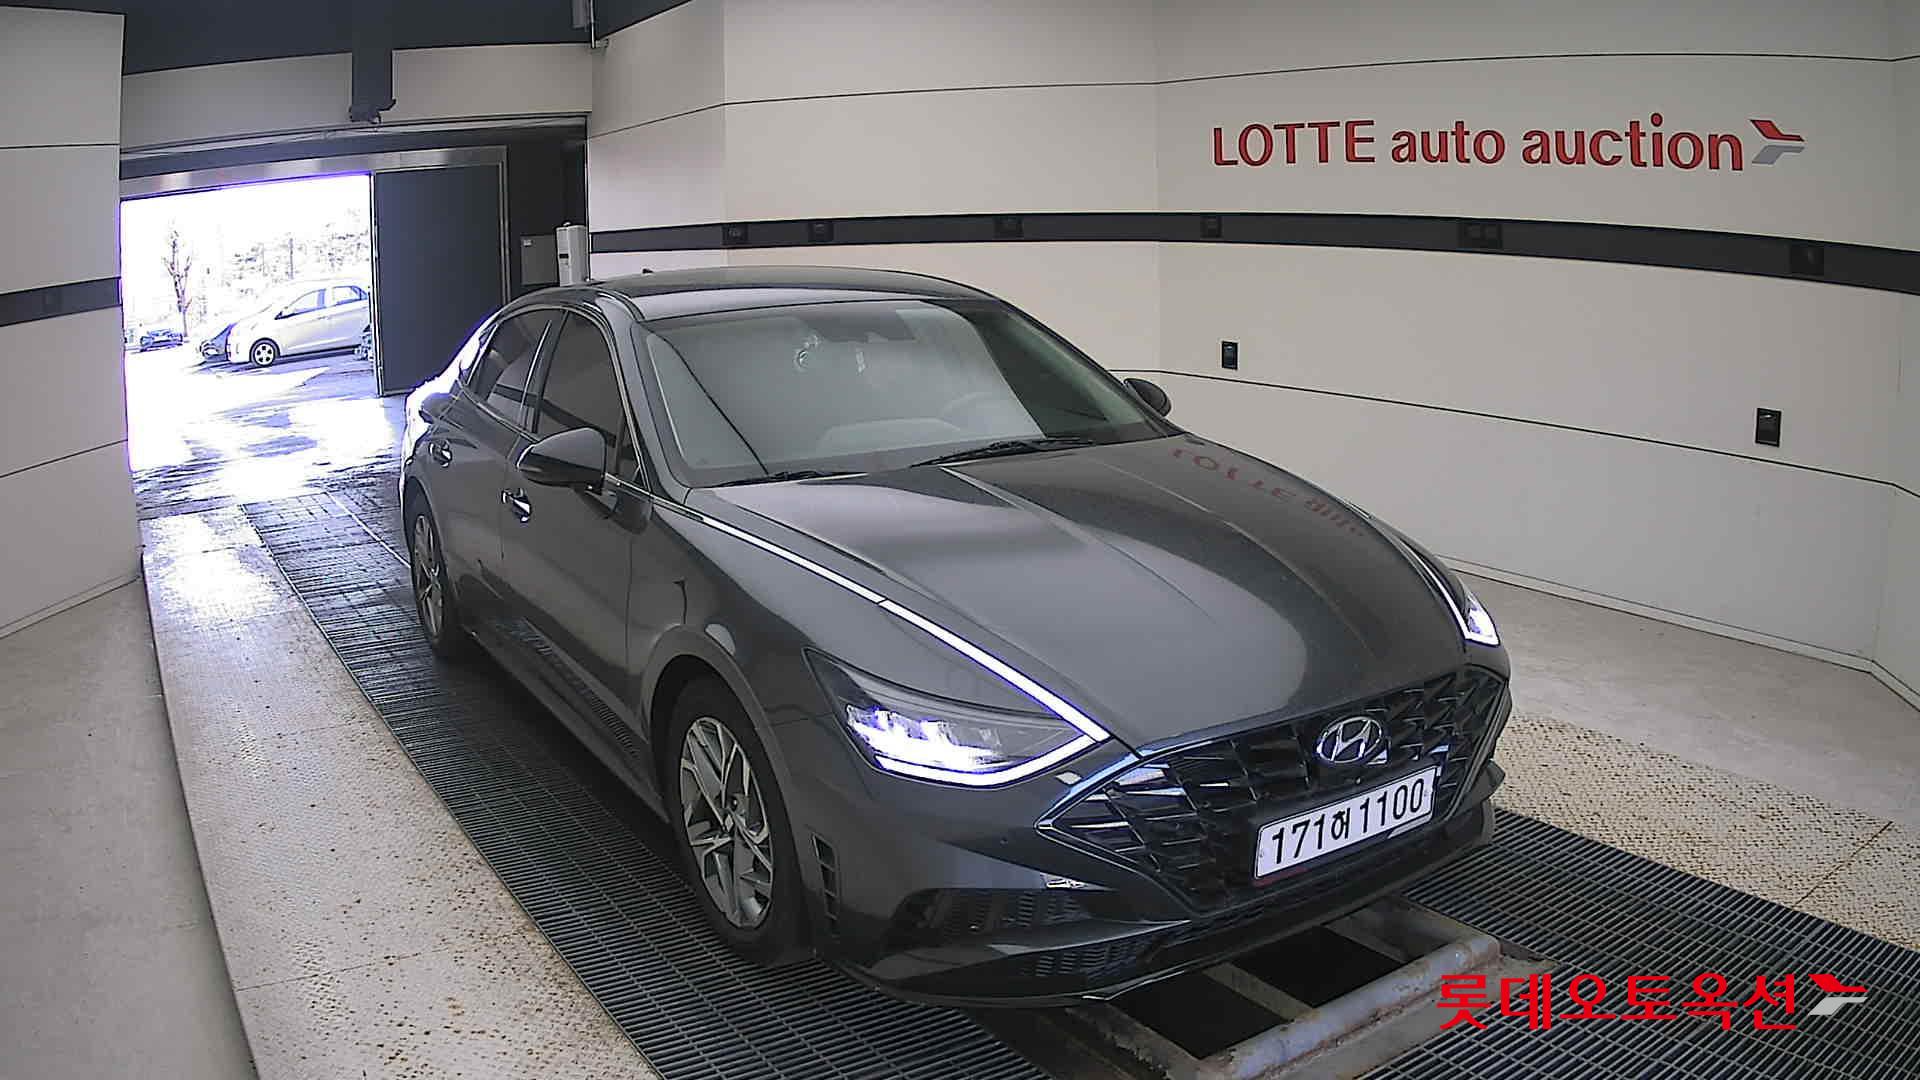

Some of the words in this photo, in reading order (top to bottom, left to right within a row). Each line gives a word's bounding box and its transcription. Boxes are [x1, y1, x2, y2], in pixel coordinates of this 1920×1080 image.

[1213, 119, 1376, 167] LOTTE
[1392, 121, 1506, 166] auto
[1523, 113, 1745, 171] auction
